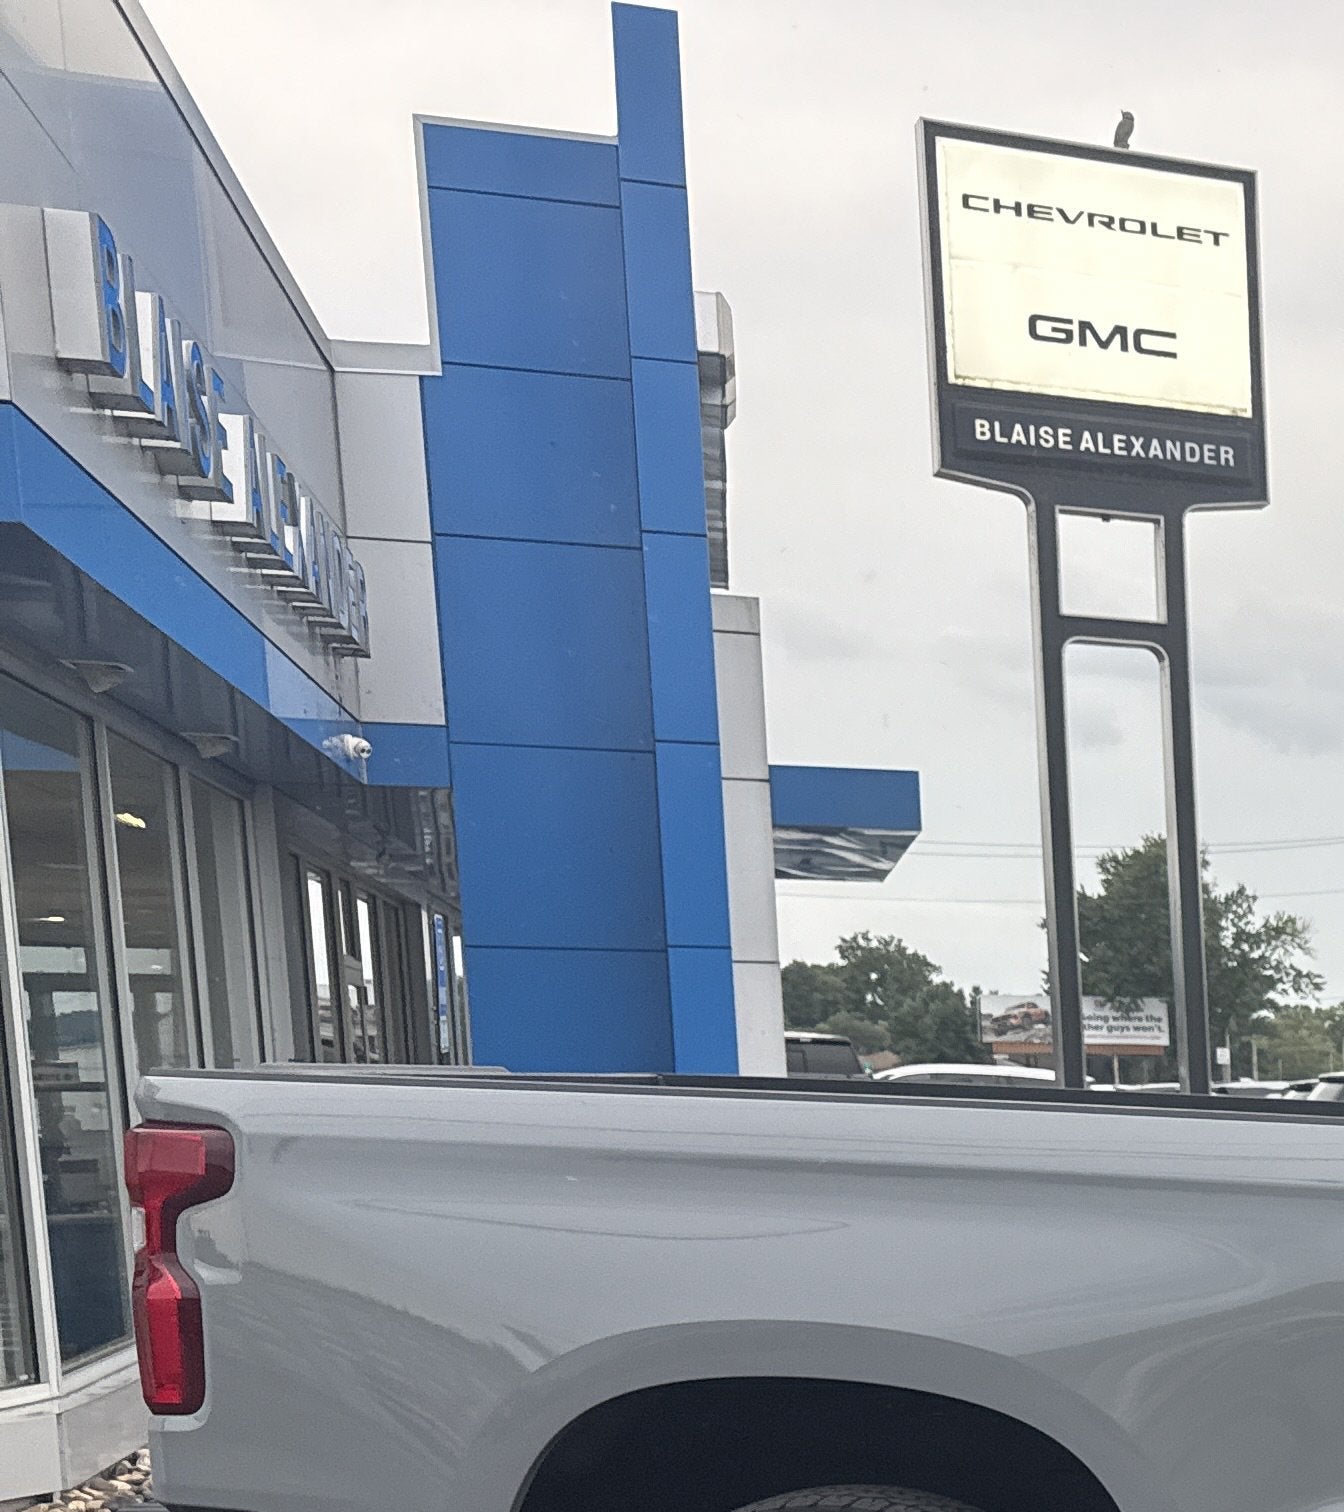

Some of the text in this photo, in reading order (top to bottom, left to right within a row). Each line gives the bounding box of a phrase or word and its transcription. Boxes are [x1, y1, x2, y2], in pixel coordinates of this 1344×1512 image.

[961, 193, 1230, 247] CHEVROLET
[1028, 313, 1178, 359] GMC
[974, 418, 1236, 467] BLAISE ALEXANDER
